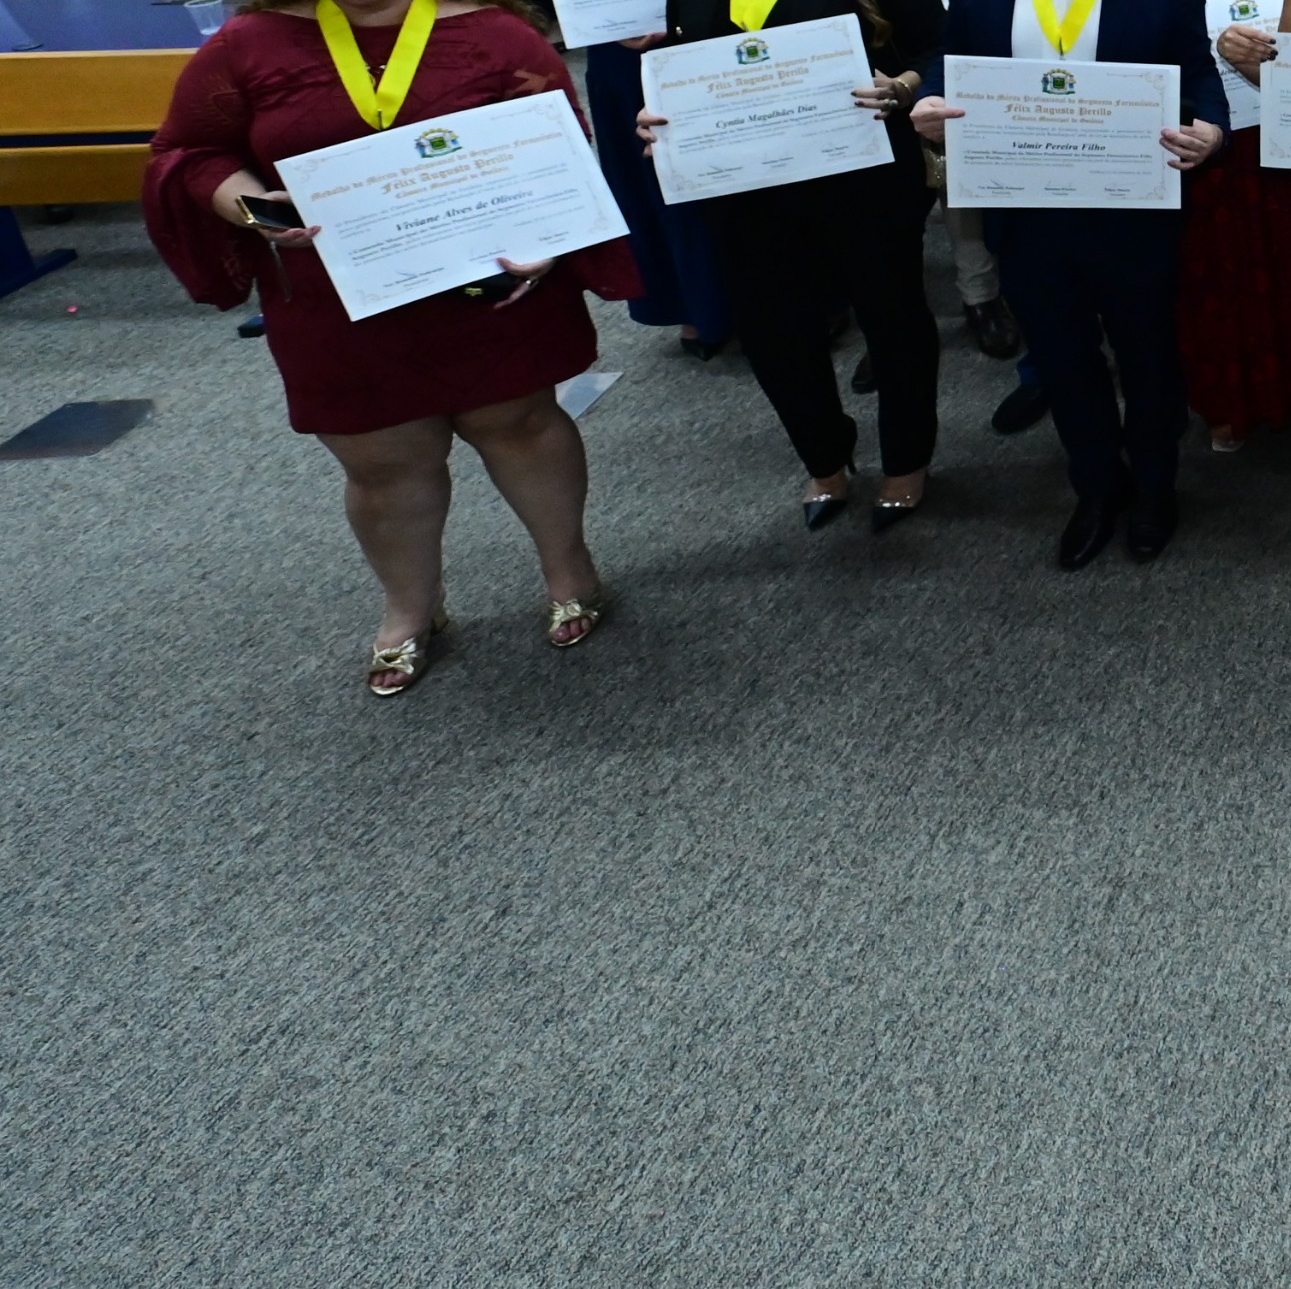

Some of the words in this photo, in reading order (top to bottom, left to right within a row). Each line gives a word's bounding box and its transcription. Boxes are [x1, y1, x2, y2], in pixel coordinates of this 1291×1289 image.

[705, 79, 732, 93] Félix
[735, 71, 773, 87] Augusto
[777, 65, 809, 79] Perillo
[715, 116, 745, 130] Cyntia
[747, 106, 794, 124] Magalhães
[796, 102, 816, 113] Dias
[1003, 103, 1030, 113] Félix
[1035, 104, 1074, 115] Augusto
[1079, 106, 1111, 116] Perillo
[1045, 142, 1077, 150] Pereira
[378, 175, 416, 194] Félix
[419, 161, 470, 183] Augusto
[473, 151, 514, 169] Perillo
[395, 213, 440, 232] Viviane
[443, 203, 473, 218] Alves
[474, 199, 488, 210] de
[490, 187, 533, 206] Oliveira
